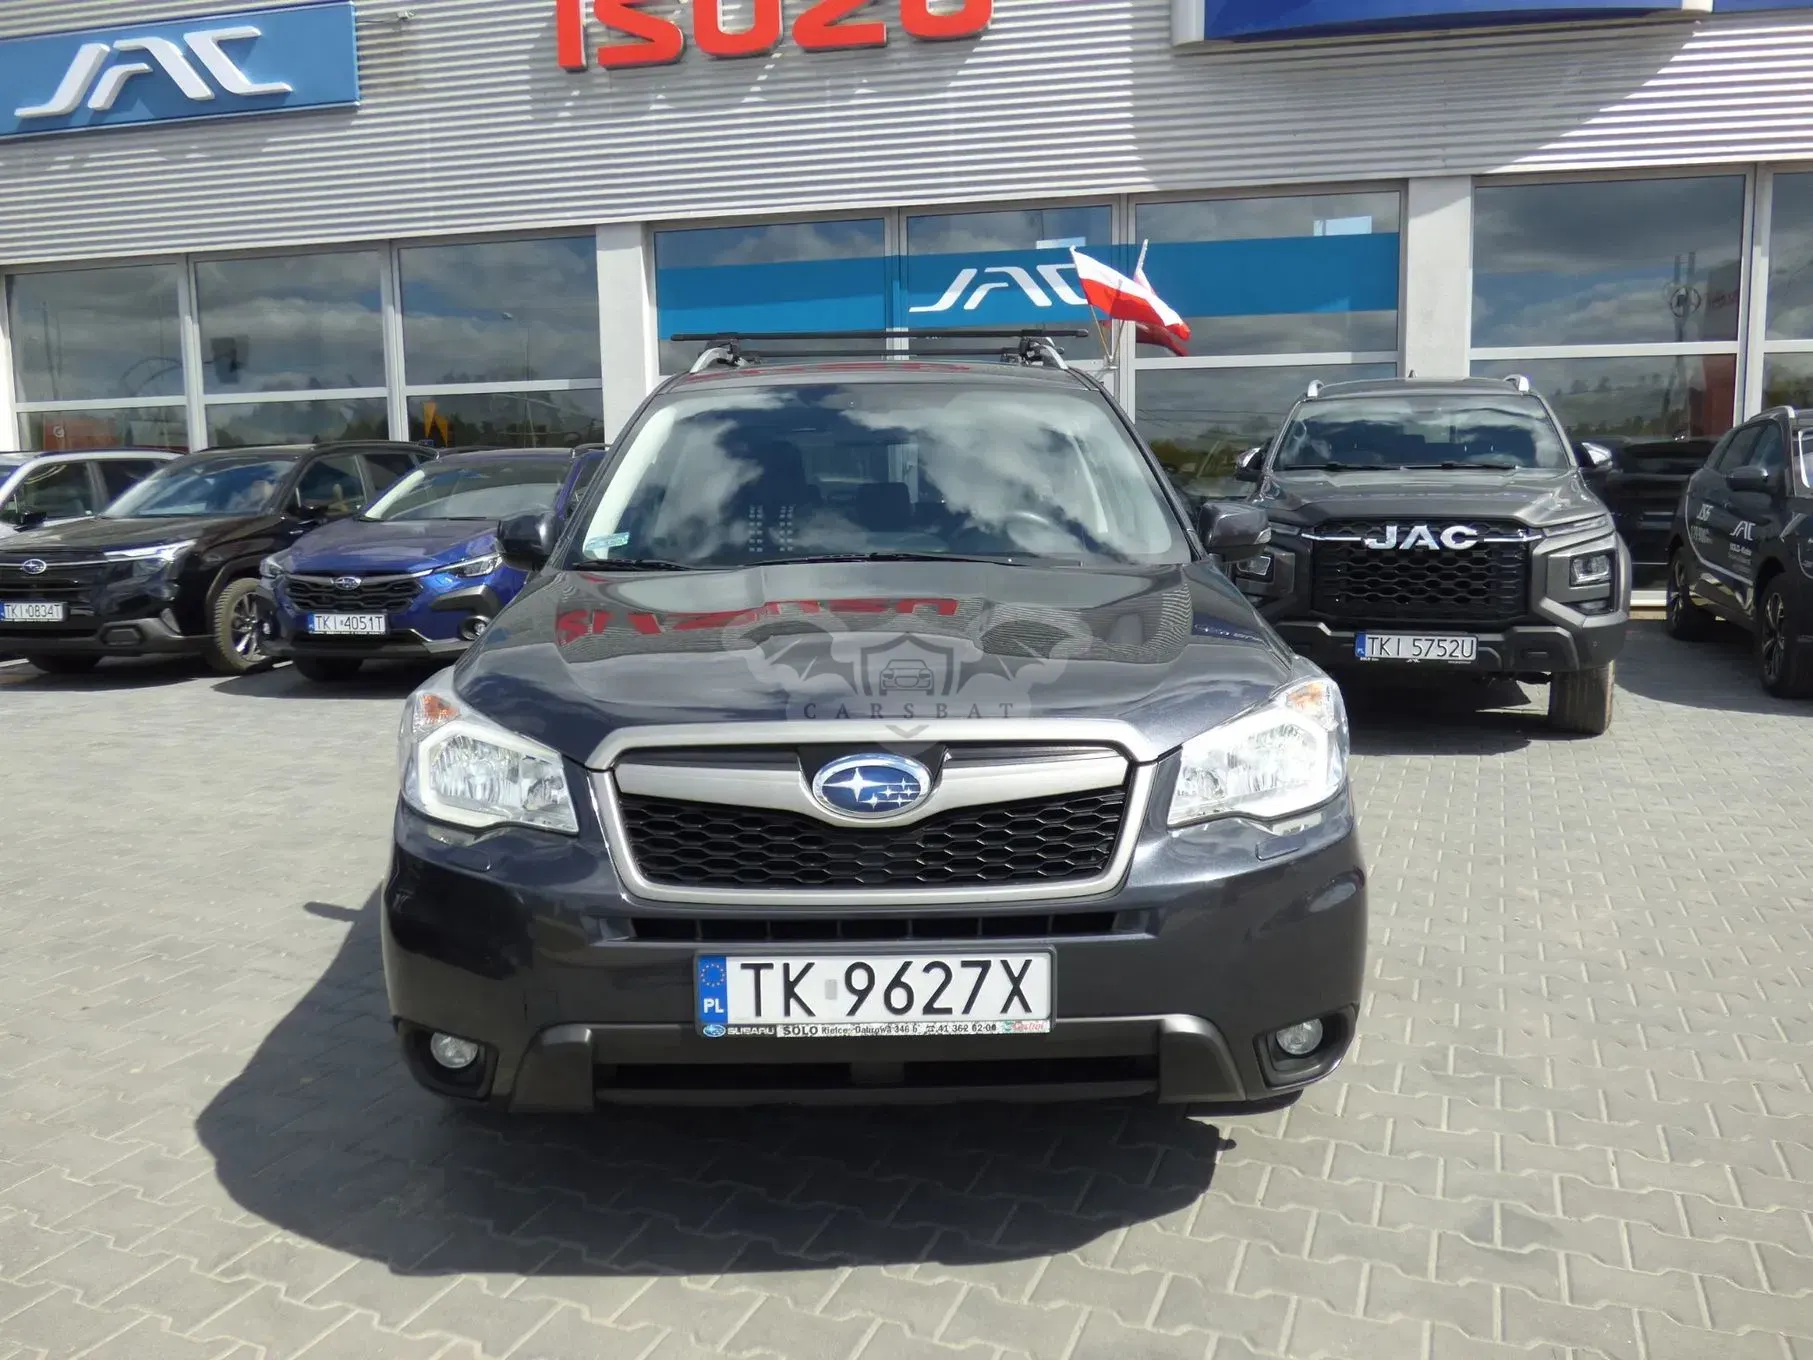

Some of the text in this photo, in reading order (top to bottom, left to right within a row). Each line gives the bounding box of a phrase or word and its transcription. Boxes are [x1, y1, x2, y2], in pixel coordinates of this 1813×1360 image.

[14, 26, 293, 117] JAC
[1364, 525, 1478, 550] JAC
[5, 604, 60, 617] TKI 0834T
[315, 615, 383, 630] TKI 4051T
[1368, 637, 1474, 658] TKI 5752U
[740, 959, 1033, 1017] TK 9627X
[703, 998, 724, 1013] PL
[727, 1026, 775, 1035] SUBARU
[783, 1025, 818, 1035] SOLO
